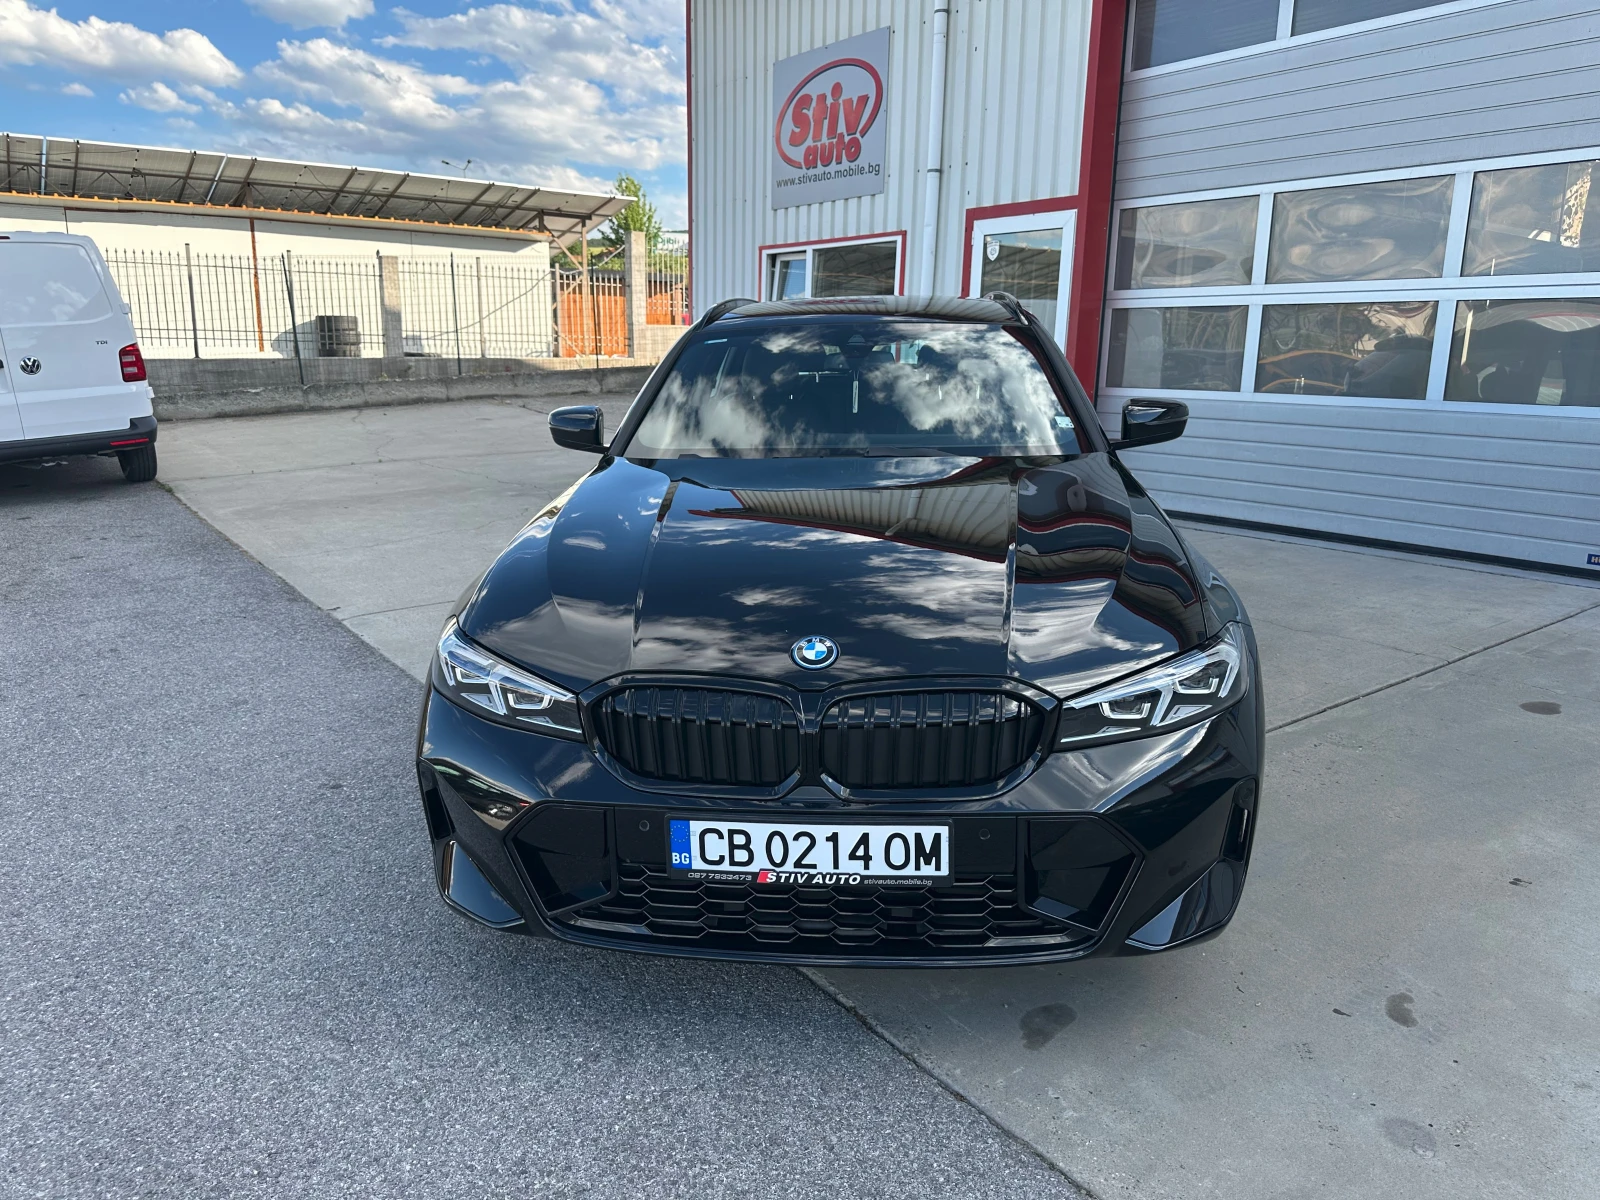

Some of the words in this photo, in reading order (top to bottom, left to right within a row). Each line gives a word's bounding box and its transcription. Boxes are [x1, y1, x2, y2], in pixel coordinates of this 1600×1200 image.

[788, 81, 870, 147] Stiv
[803, 132, 862, 170] auto
[776, 162, 881, 188] www.stivauto.mobile.bg
[671, 852, 690, 865] BG
[698, 827, 755, 867] CB
[765, 830, 873, 871] 0214
[884, 832, 942, 872] OM
[766, 872, 809, 884] STIV
[811, 874, 861, 885] AUTO
[863, 878, 933, 886] stivauto.mobile.bg
